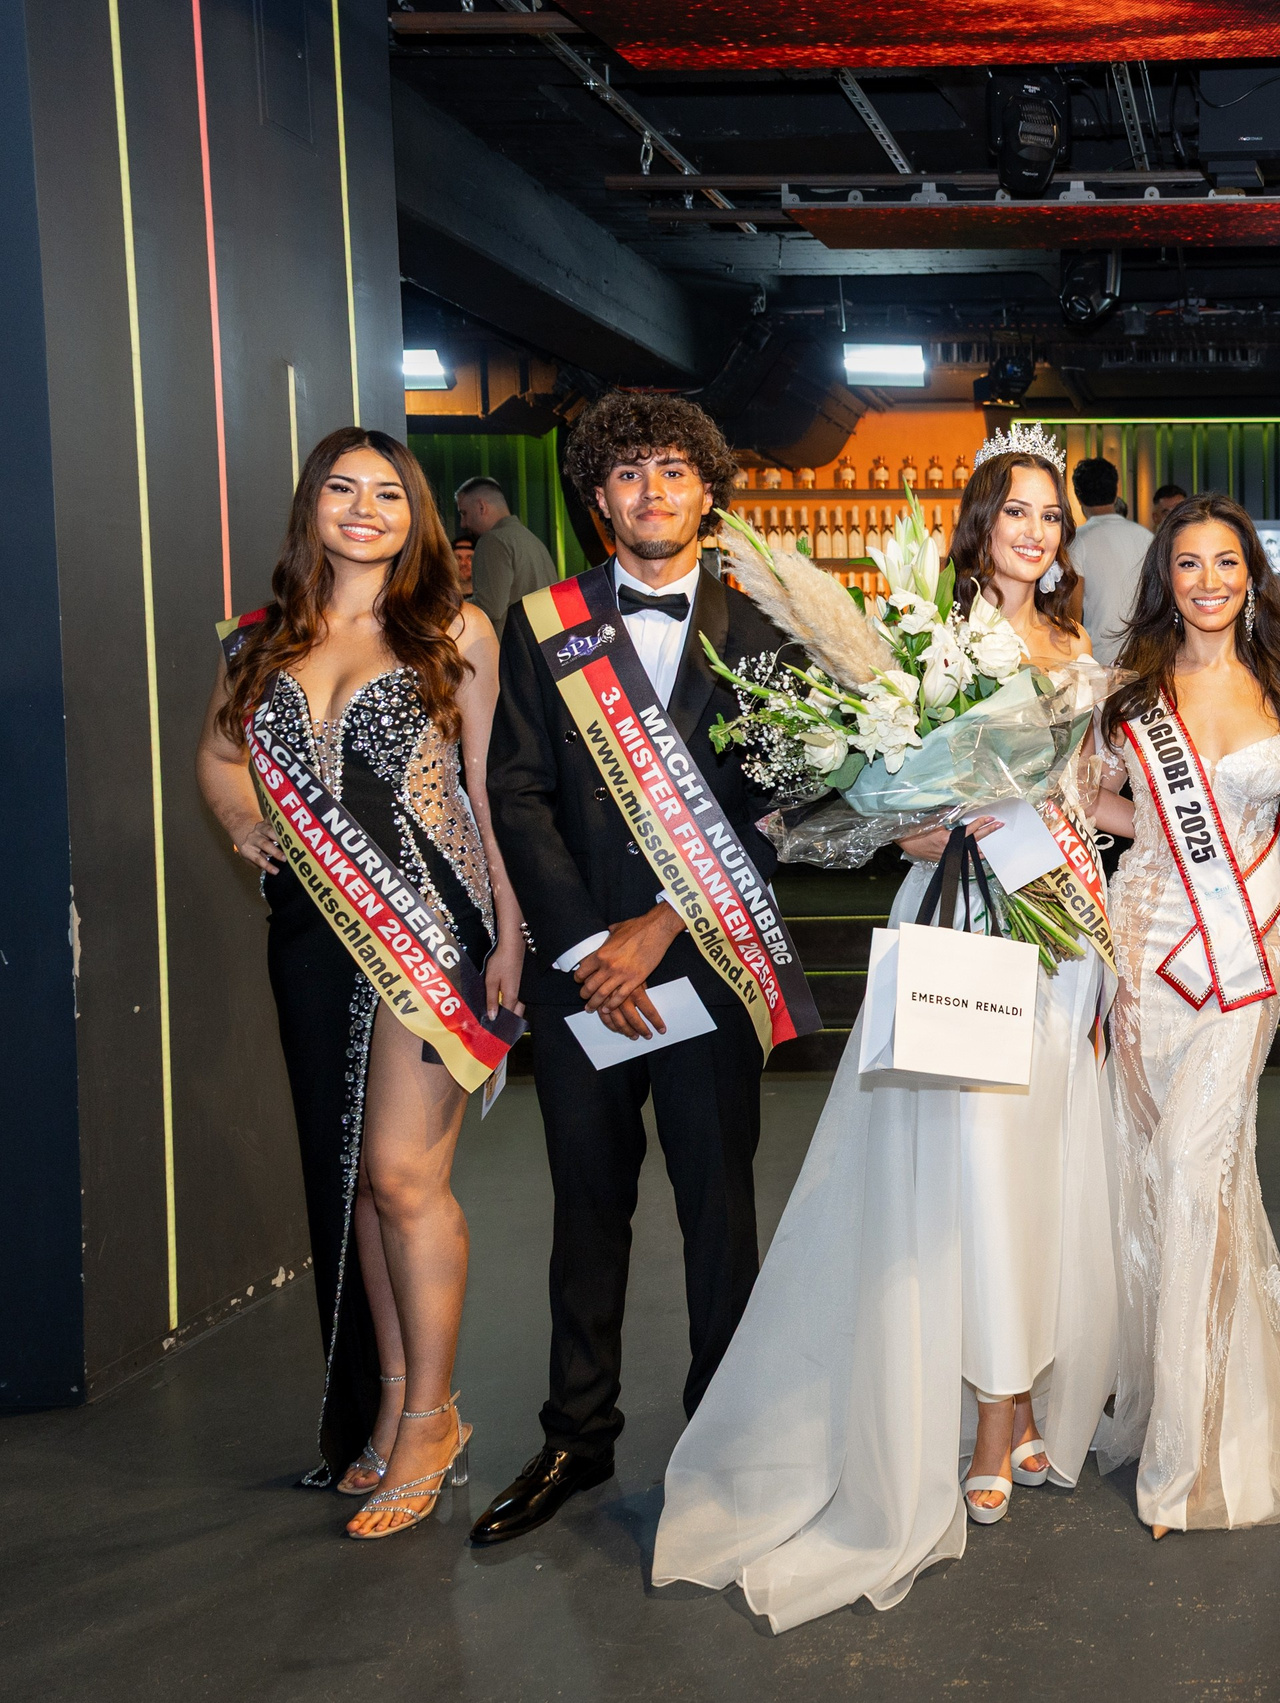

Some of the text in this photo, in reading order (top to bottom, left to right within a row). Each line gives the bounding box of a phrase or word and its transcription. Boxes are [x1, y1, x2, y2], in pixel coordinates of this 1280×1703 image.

[244, 721, 462, 1018] MISS FRANKEN 2025/26
[252, 701, 461, 971] MACH1 NÜRNBERG
[587, 719, 759, 1006] www.missdeutschland.tv
[600, 686, 779, 1009] 3. MISTER FRANKEN 2025/26
[639, 705, 794, 967] MACH1 NÜRNBERG
[1175, 800, 1217, 864] 2025
[910, 991, 1023, 1018] EMERSON RENALDI
